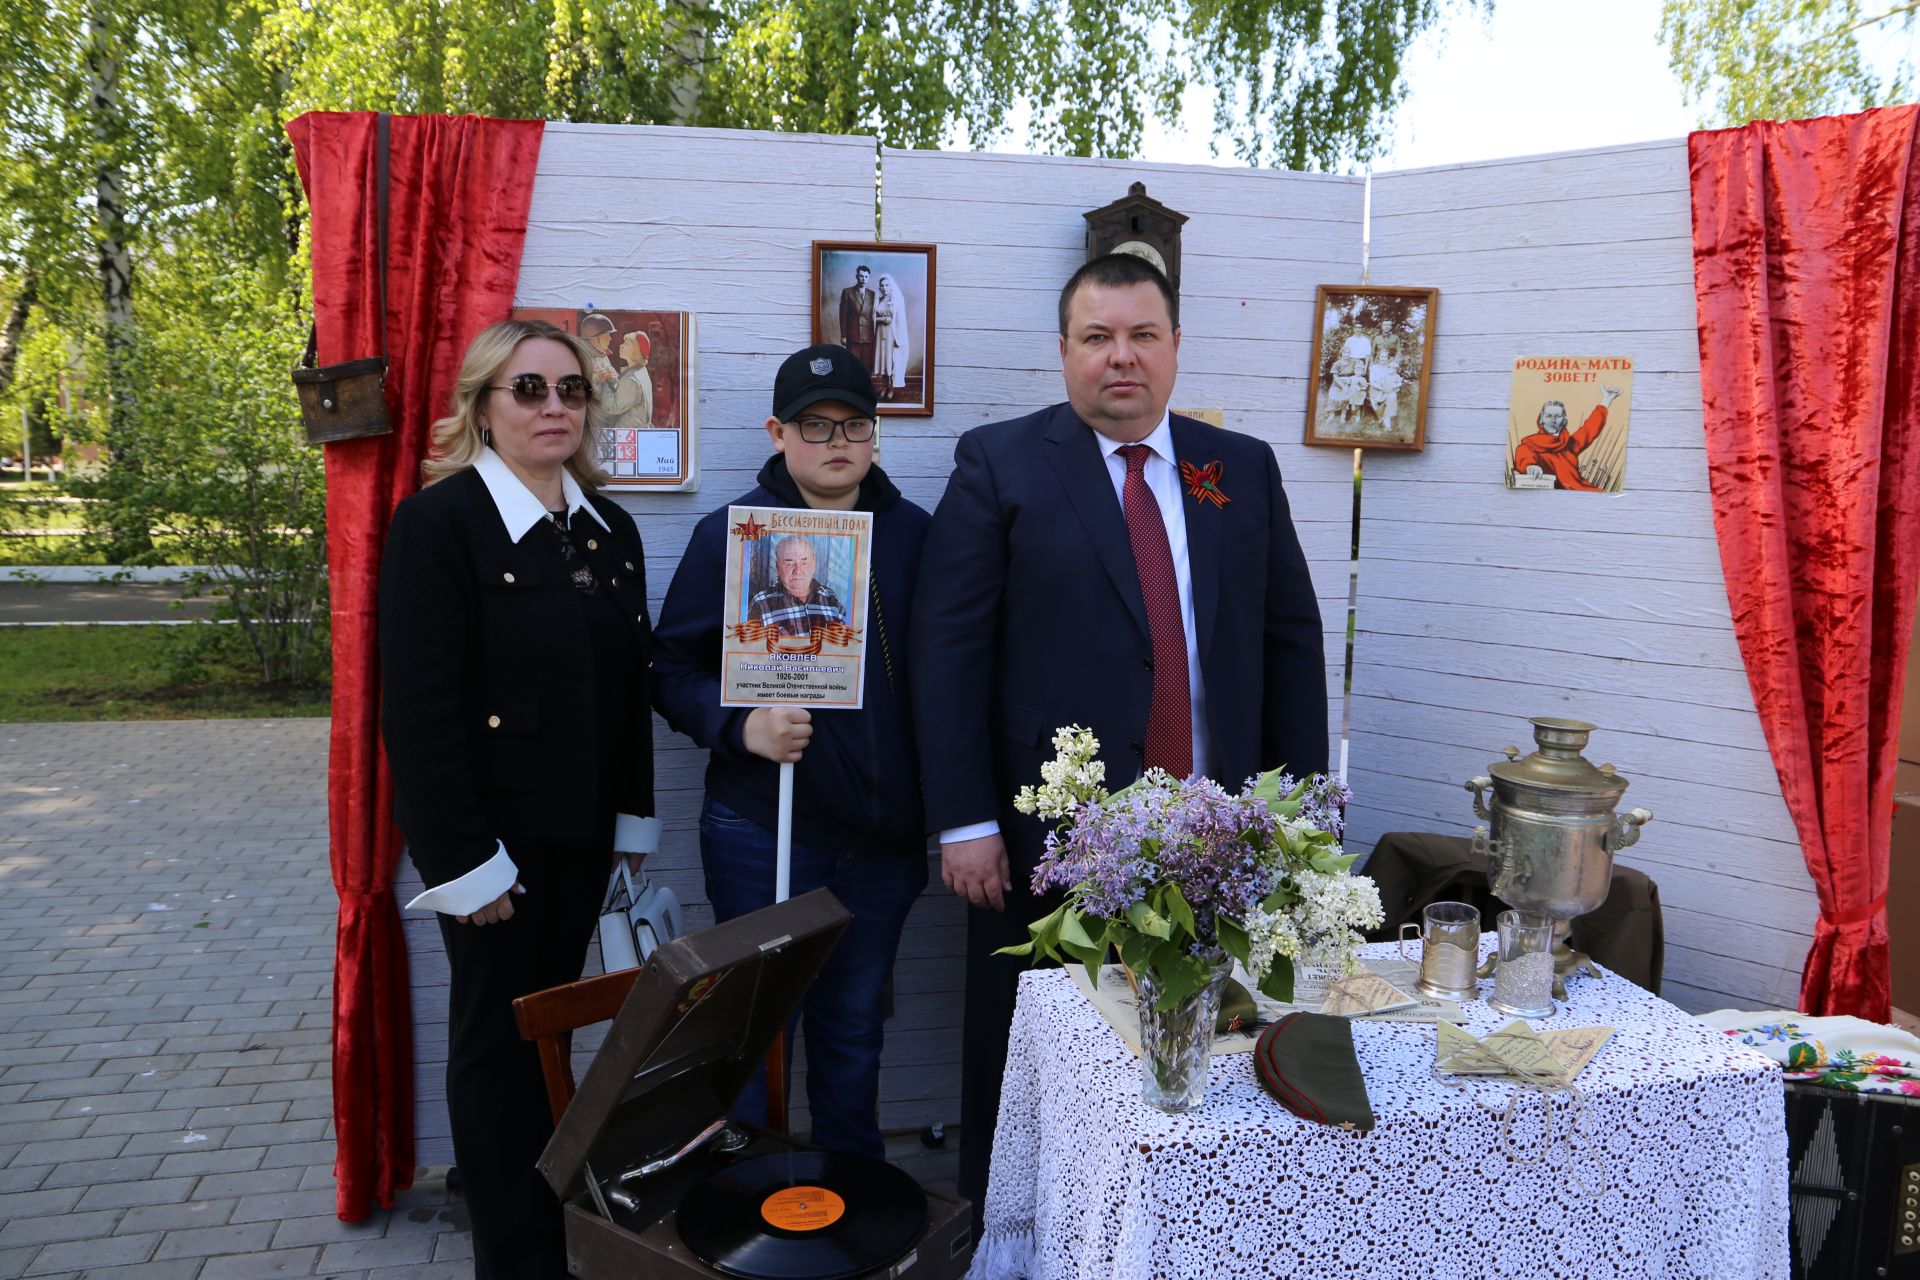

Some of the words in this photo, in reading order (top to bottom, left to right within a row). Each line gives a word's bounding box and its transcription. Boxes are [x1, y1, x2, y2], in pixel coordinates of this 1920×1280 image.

[1516, 358, 1632, 370] РОДИНА-МАТЬ
[1543, 372, 1597, 383] ЗОВЕТ!
[656, 456, 675, 465] Май
[768, 653, 817, 662] ЯКОВЛЕВ
[739, 662, 783, 671] Николай
[785, 664, 844, 673] Васильевич
[776, 673, 808, 681] 1926-2001
[762, 682, 786, 690] Великой
[787, 682, 828, 691] Отечественной
[776, 691, 799, 699] боевые
[799, 692, 825, 700] награды
